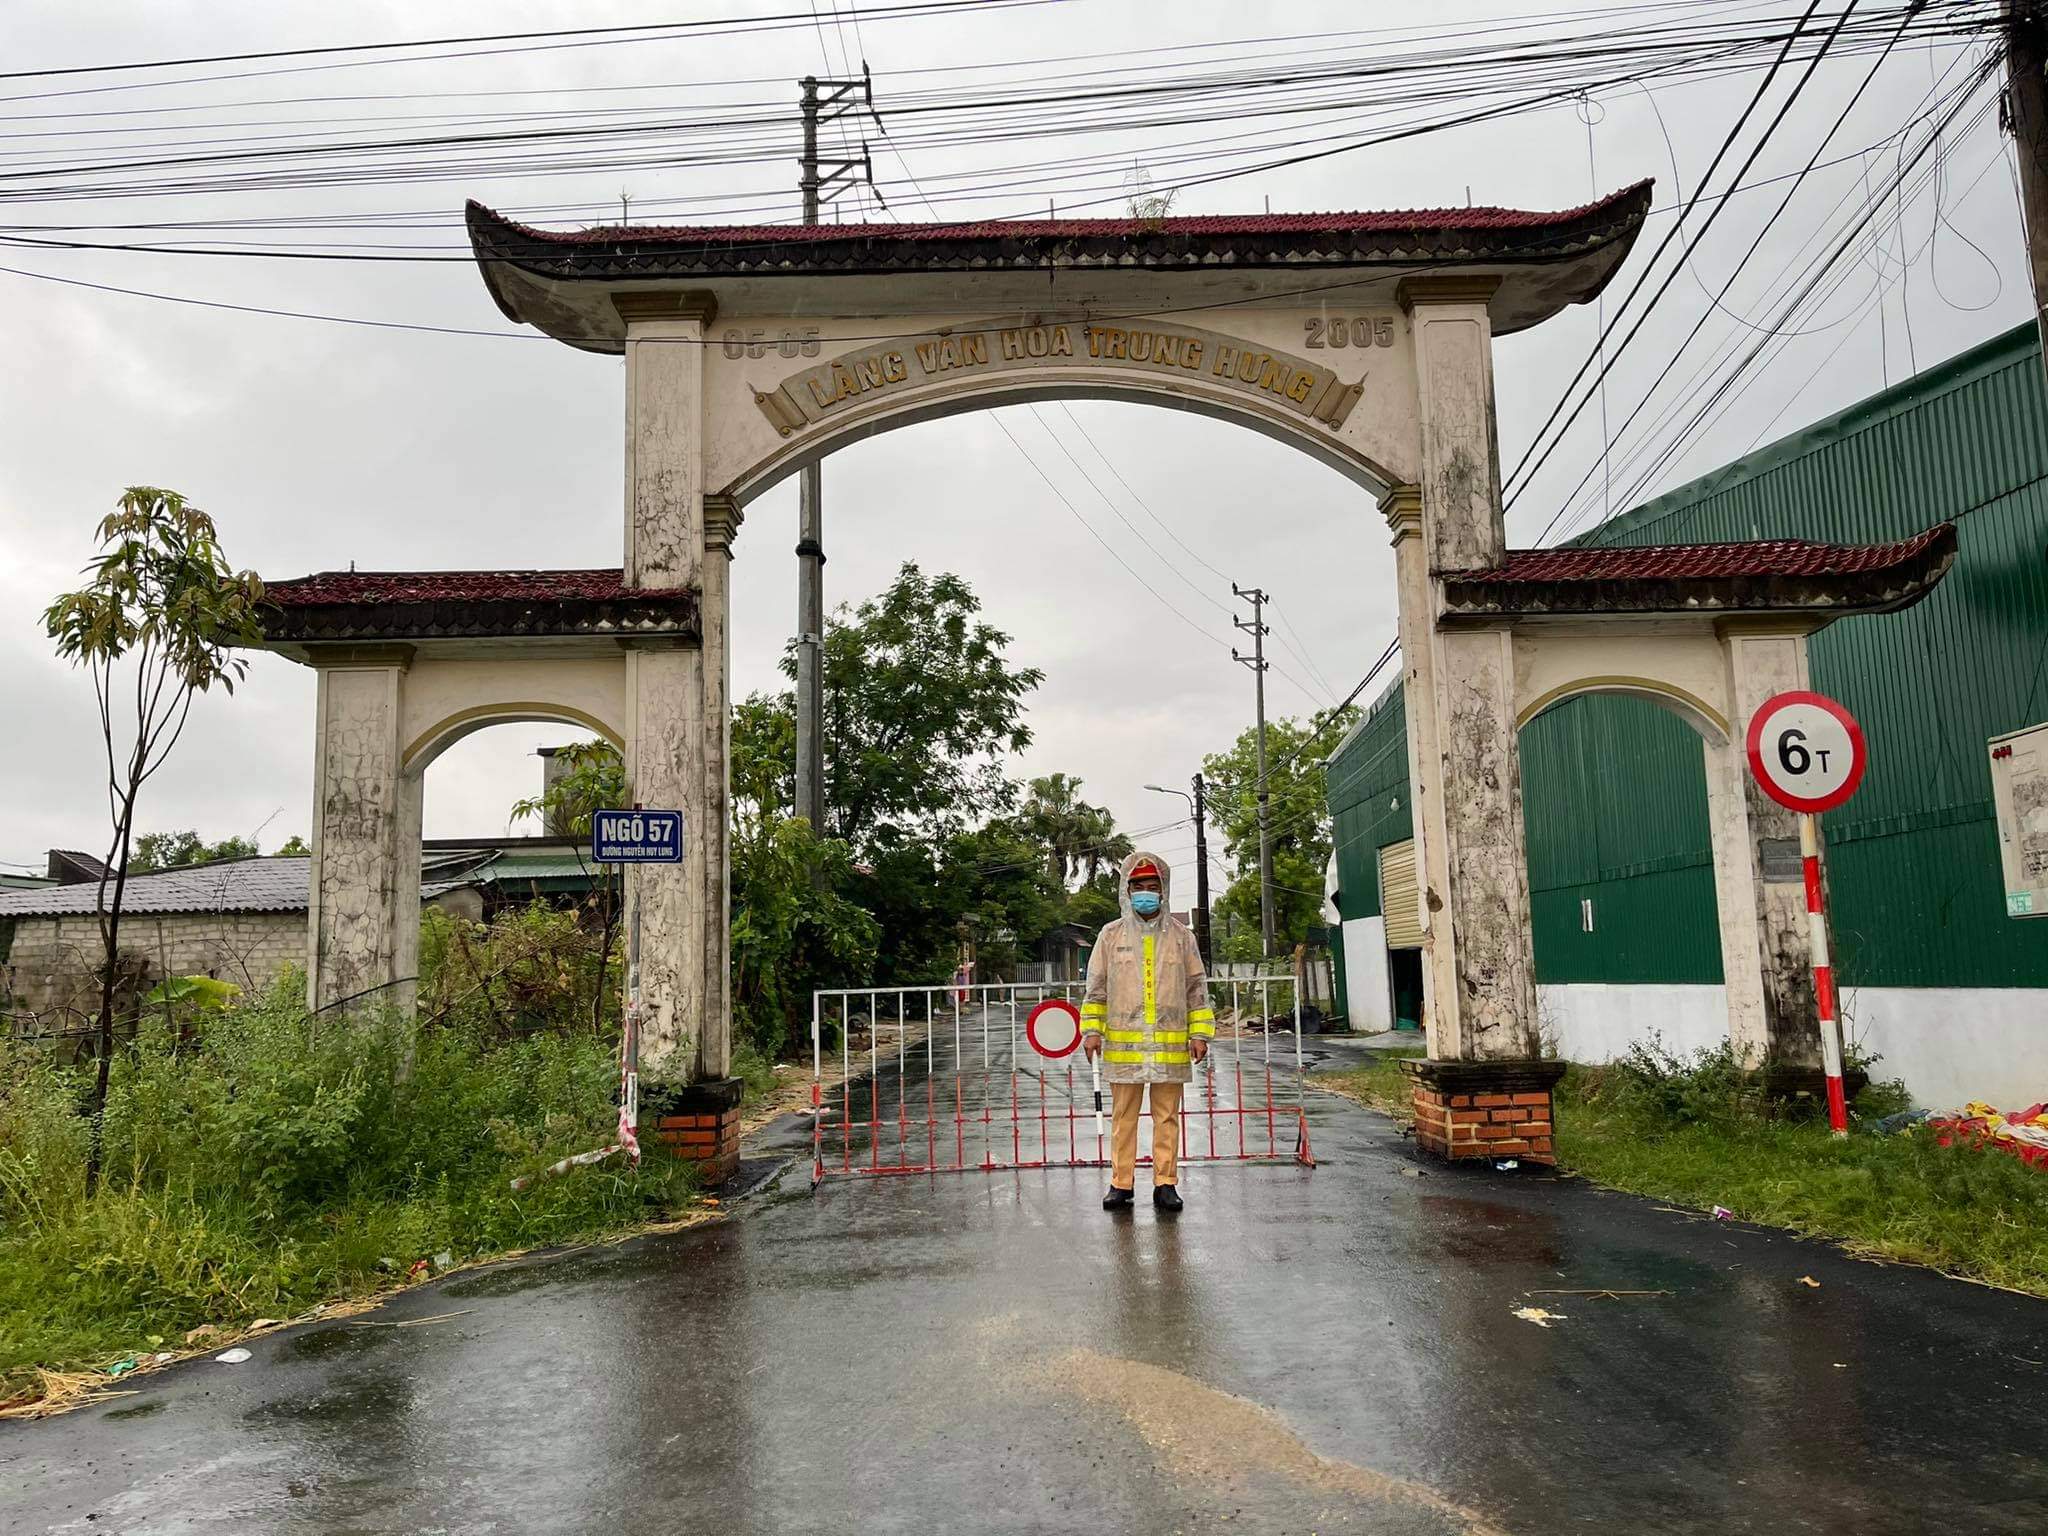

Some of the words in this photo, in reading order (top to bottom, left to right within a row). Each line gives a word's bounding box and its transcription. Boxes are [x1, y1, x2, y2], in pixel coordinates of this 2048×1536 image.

[1304, 316, 1395, 349] 2005
[808, 351, 908, 408] LÀNG
[1089, 327, 1203, 370] TRUNG
[1212, 343, 1315, 404] HƯNG
[601, 814, 644, 842] NGÕ
[648, 819, 673, 842] 57
